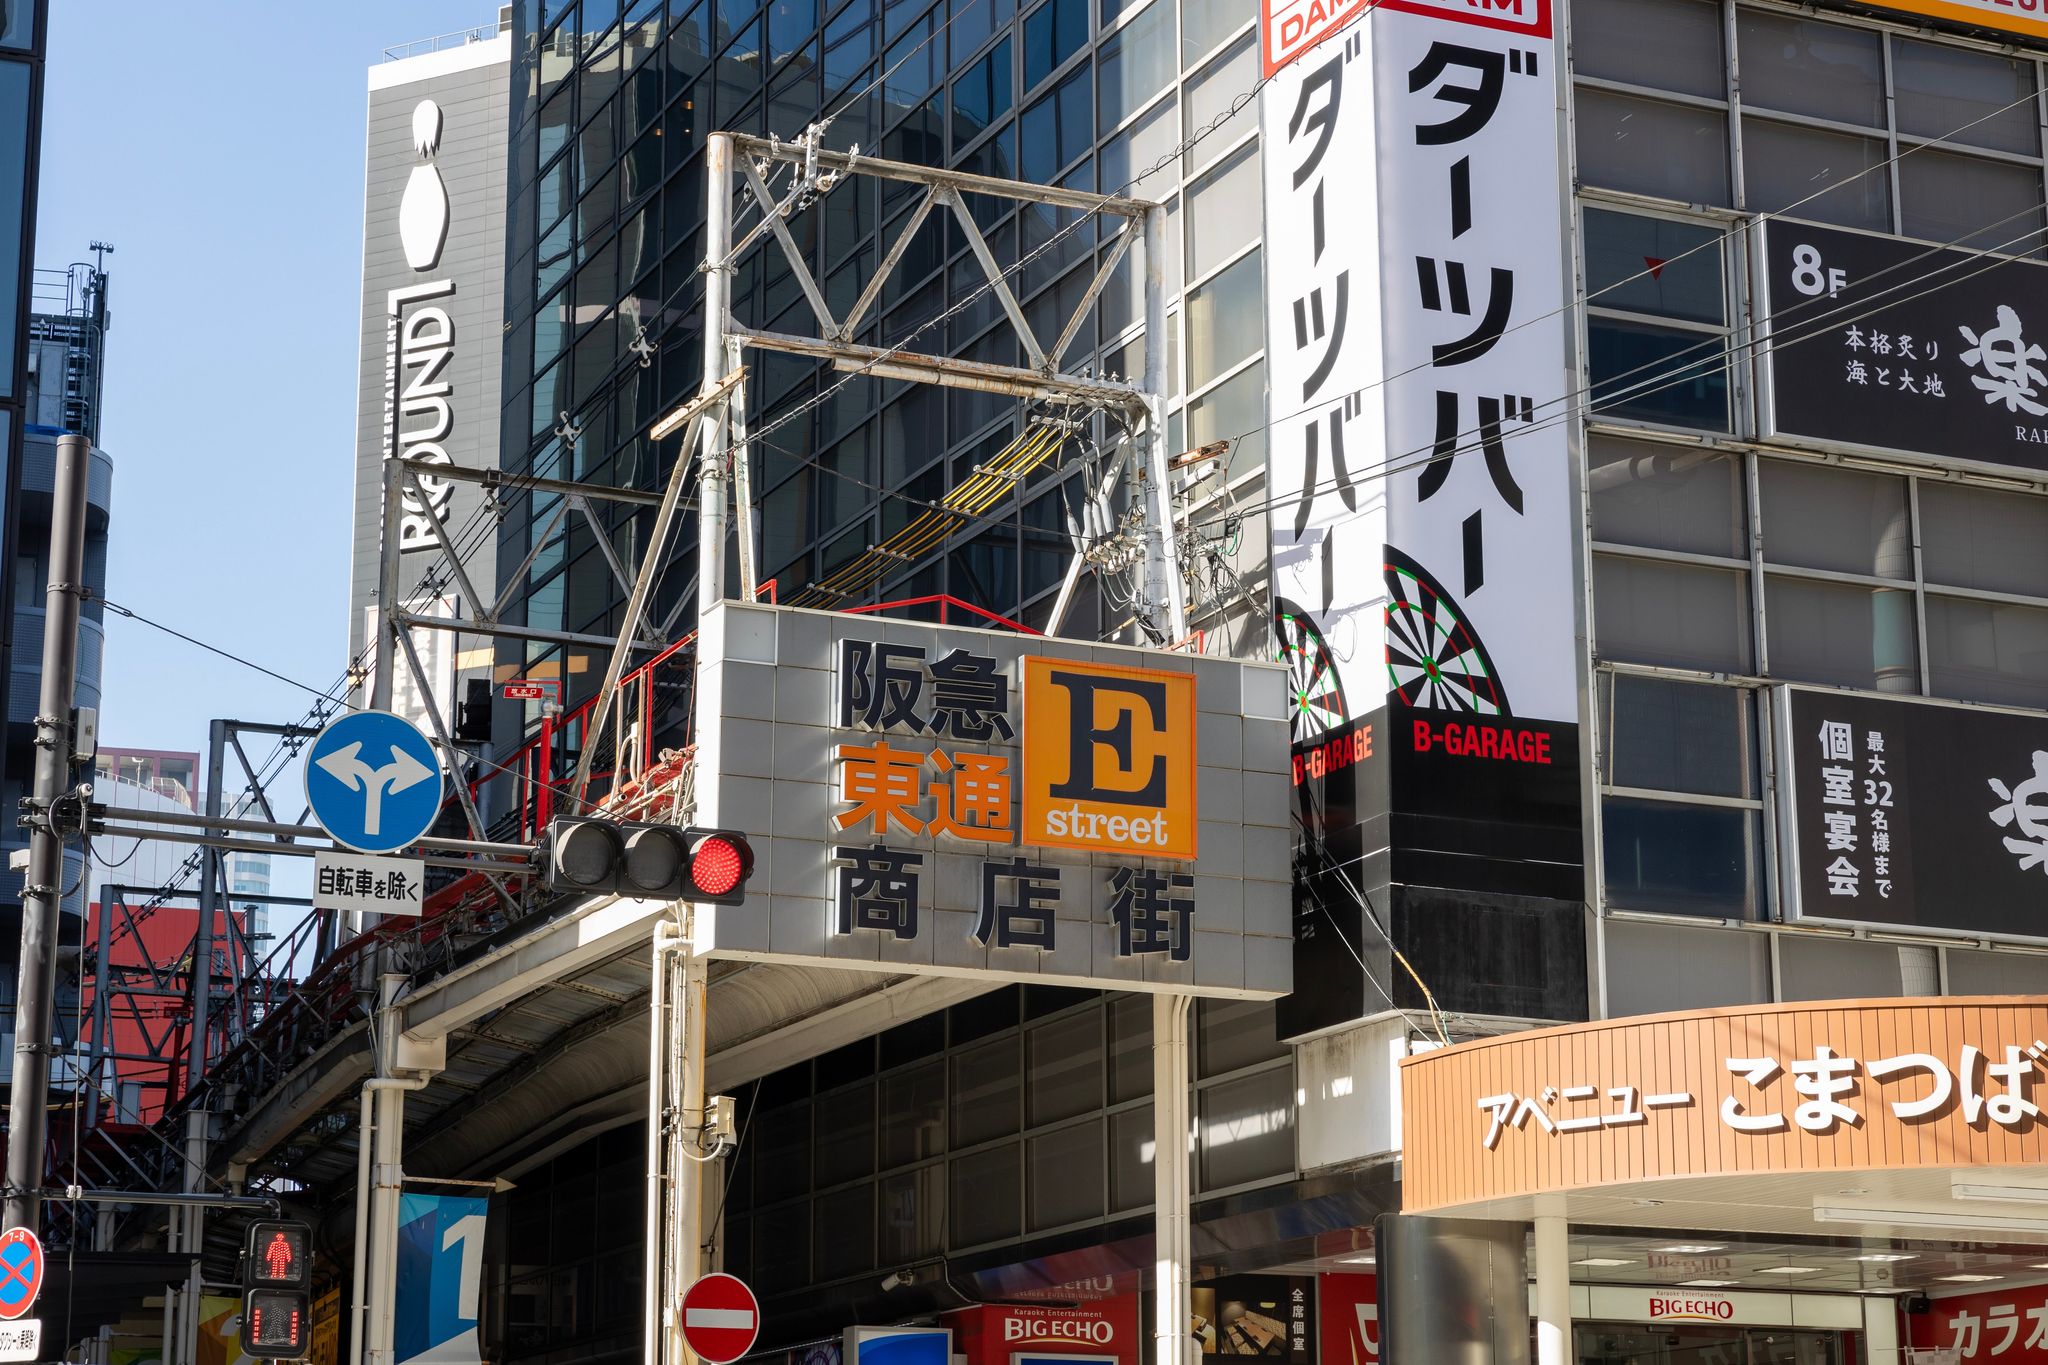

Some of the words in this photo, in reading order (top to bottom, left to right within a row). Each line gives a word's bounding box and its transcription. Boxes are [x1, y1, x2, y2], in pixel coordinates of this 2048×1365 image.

[1792, 244, 1846, 298] 8F
[1289, 30, 1361, 618] ダーツバー
[1408, 41, 1538, 598] ダーツバー
[1845, 325, 1938, 361] 本格炙り
[382, 318, 398, 471] NTERTAINMENT
[1846, 361, 1946, 397] 海と大地
[838, 638, 1015, 742] 阪急
[1050, 670, 1166, 808] E
[1292, 724, 1373, 787] B-GARAGE
[1413, 720, 1551, 764] B-GARAGE
[832, 741, 1015, 843] 東通
[1818, 720, 1860, 898] 個室宴会
[1863, 731, 1894, 899] 最大32名様まで
[1047, 803, 1168, 846] street
[319, 865, 418, 902] 自転車を除く
[833, 844, 1195, 963] 商店街
[1477, 1086, 1690, 1149] アベニュー
[1721, 1039, 2048, 1130] こまつば
[1005, 1317, 1047, 1341] BIG
[1052, 1320, 1113, 1343] ECHO
[1014, 1308, 1044, 1316] Karaoke
[1047, 1309, 1102, 1318] Entertainment
[1292, 1288, 1305, 1351] 全席個室
[1650, 1298, 1682, 1317] BIG
[1685, 1300, 1733, 1319] ECHO
